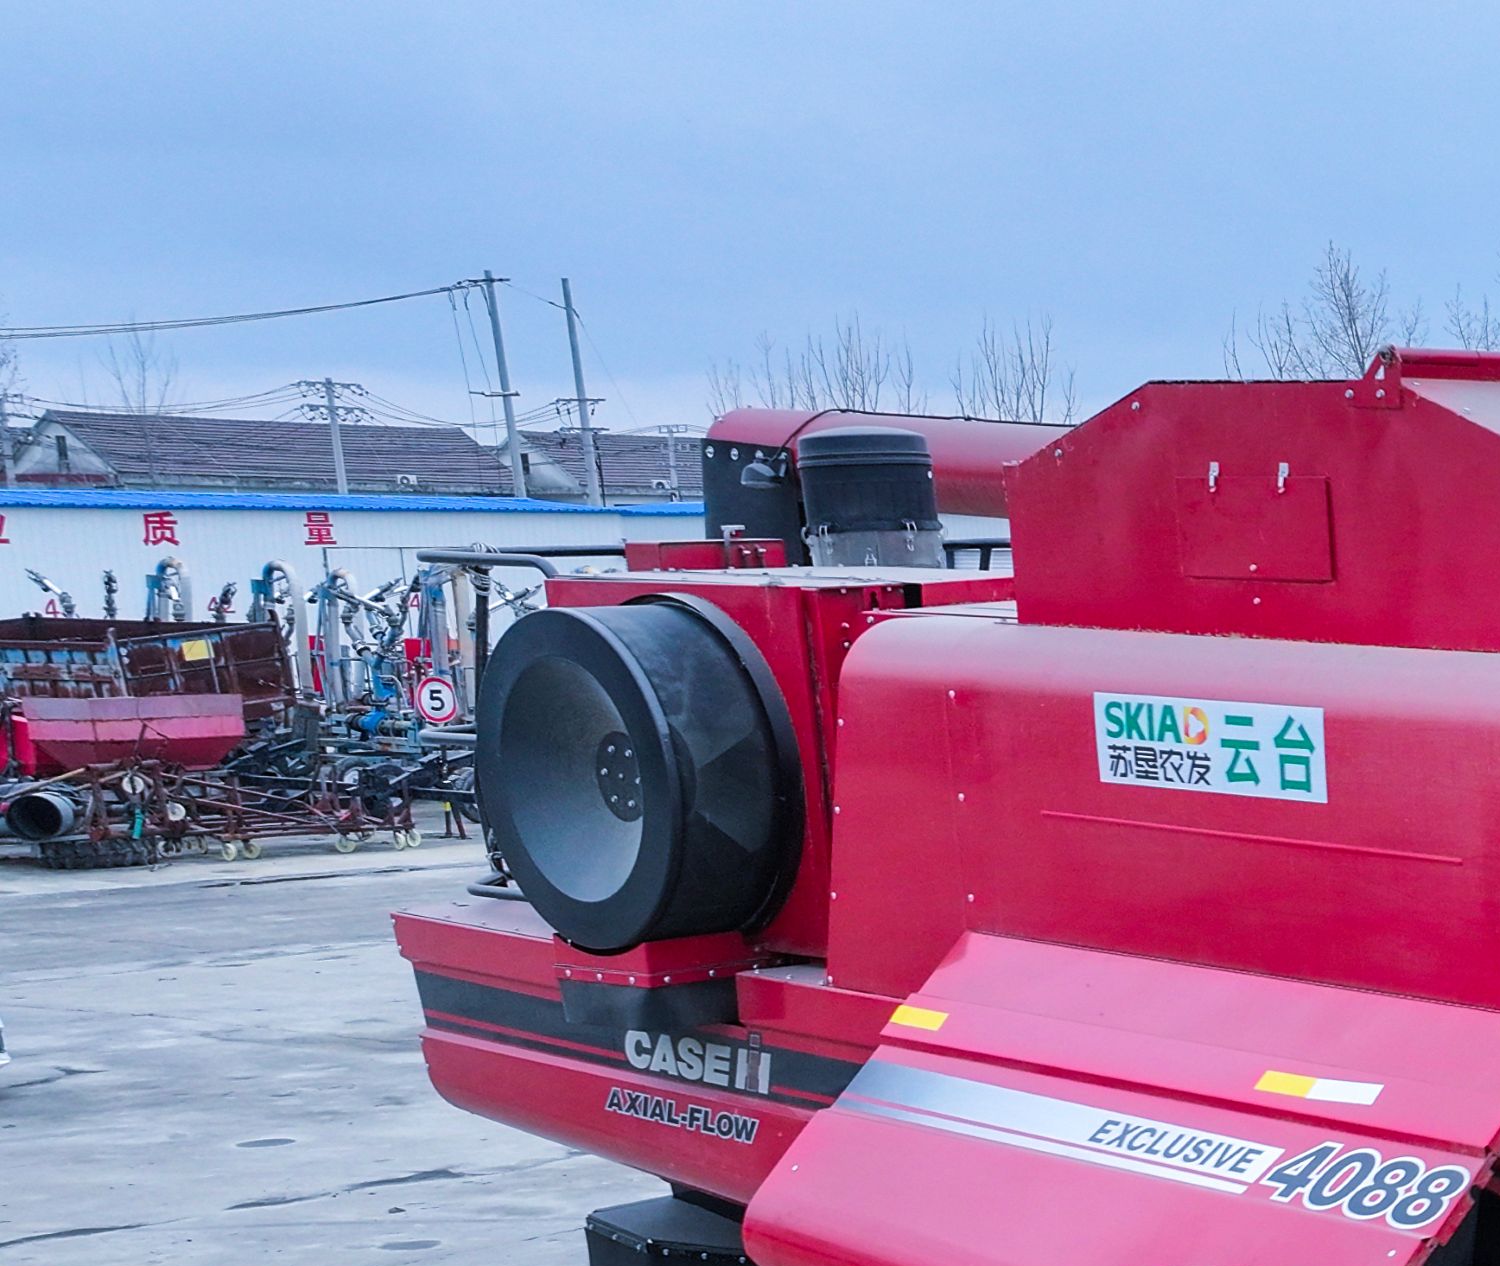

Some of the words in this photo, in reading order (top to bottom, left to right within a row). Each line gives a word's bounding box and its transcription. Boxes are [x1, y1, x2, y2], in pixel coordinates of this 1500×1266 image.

[429, 689, 446, 712] 5
[1106, 743, 1212, 786] 苏垦农发
[1220, 714, 1316, 793] 云台
[624, 1029, 731, 1088] CASE
[604, 1087, 760, 1144] AXIAL-FLOW
[1087, 1119, 1265, 1175] EXCLUSIVE
[1261, 1141, 1470, 1229] 4088
